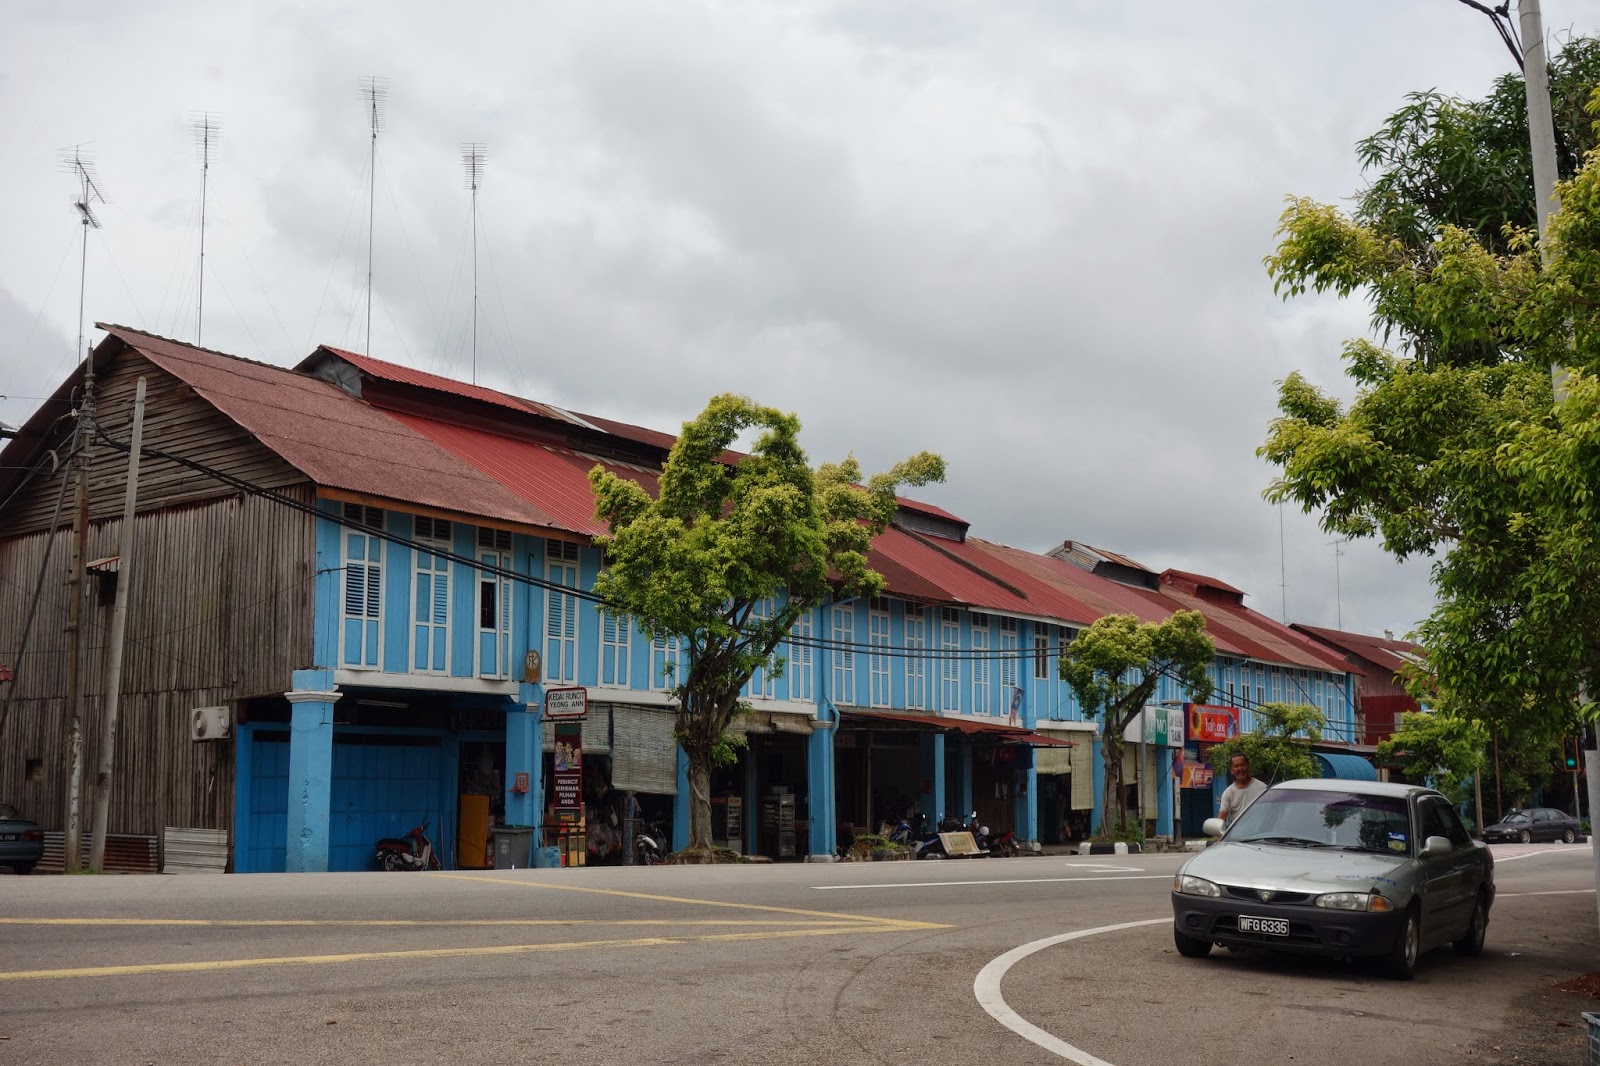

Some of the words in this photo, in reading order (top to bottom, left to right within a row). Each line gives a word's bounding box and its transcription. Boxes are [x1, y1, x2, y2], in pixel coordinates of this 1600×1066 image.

[549, 693, 564, 701] KEDAI
[566, 691, 585, 700] RUNCIT
[550, 701, 569, 709] YEONG
[572, 700, 584, 708] ANN
[1240, 917, 1260, 931] WFG
[1260, 920, 1288, 934] 6335
